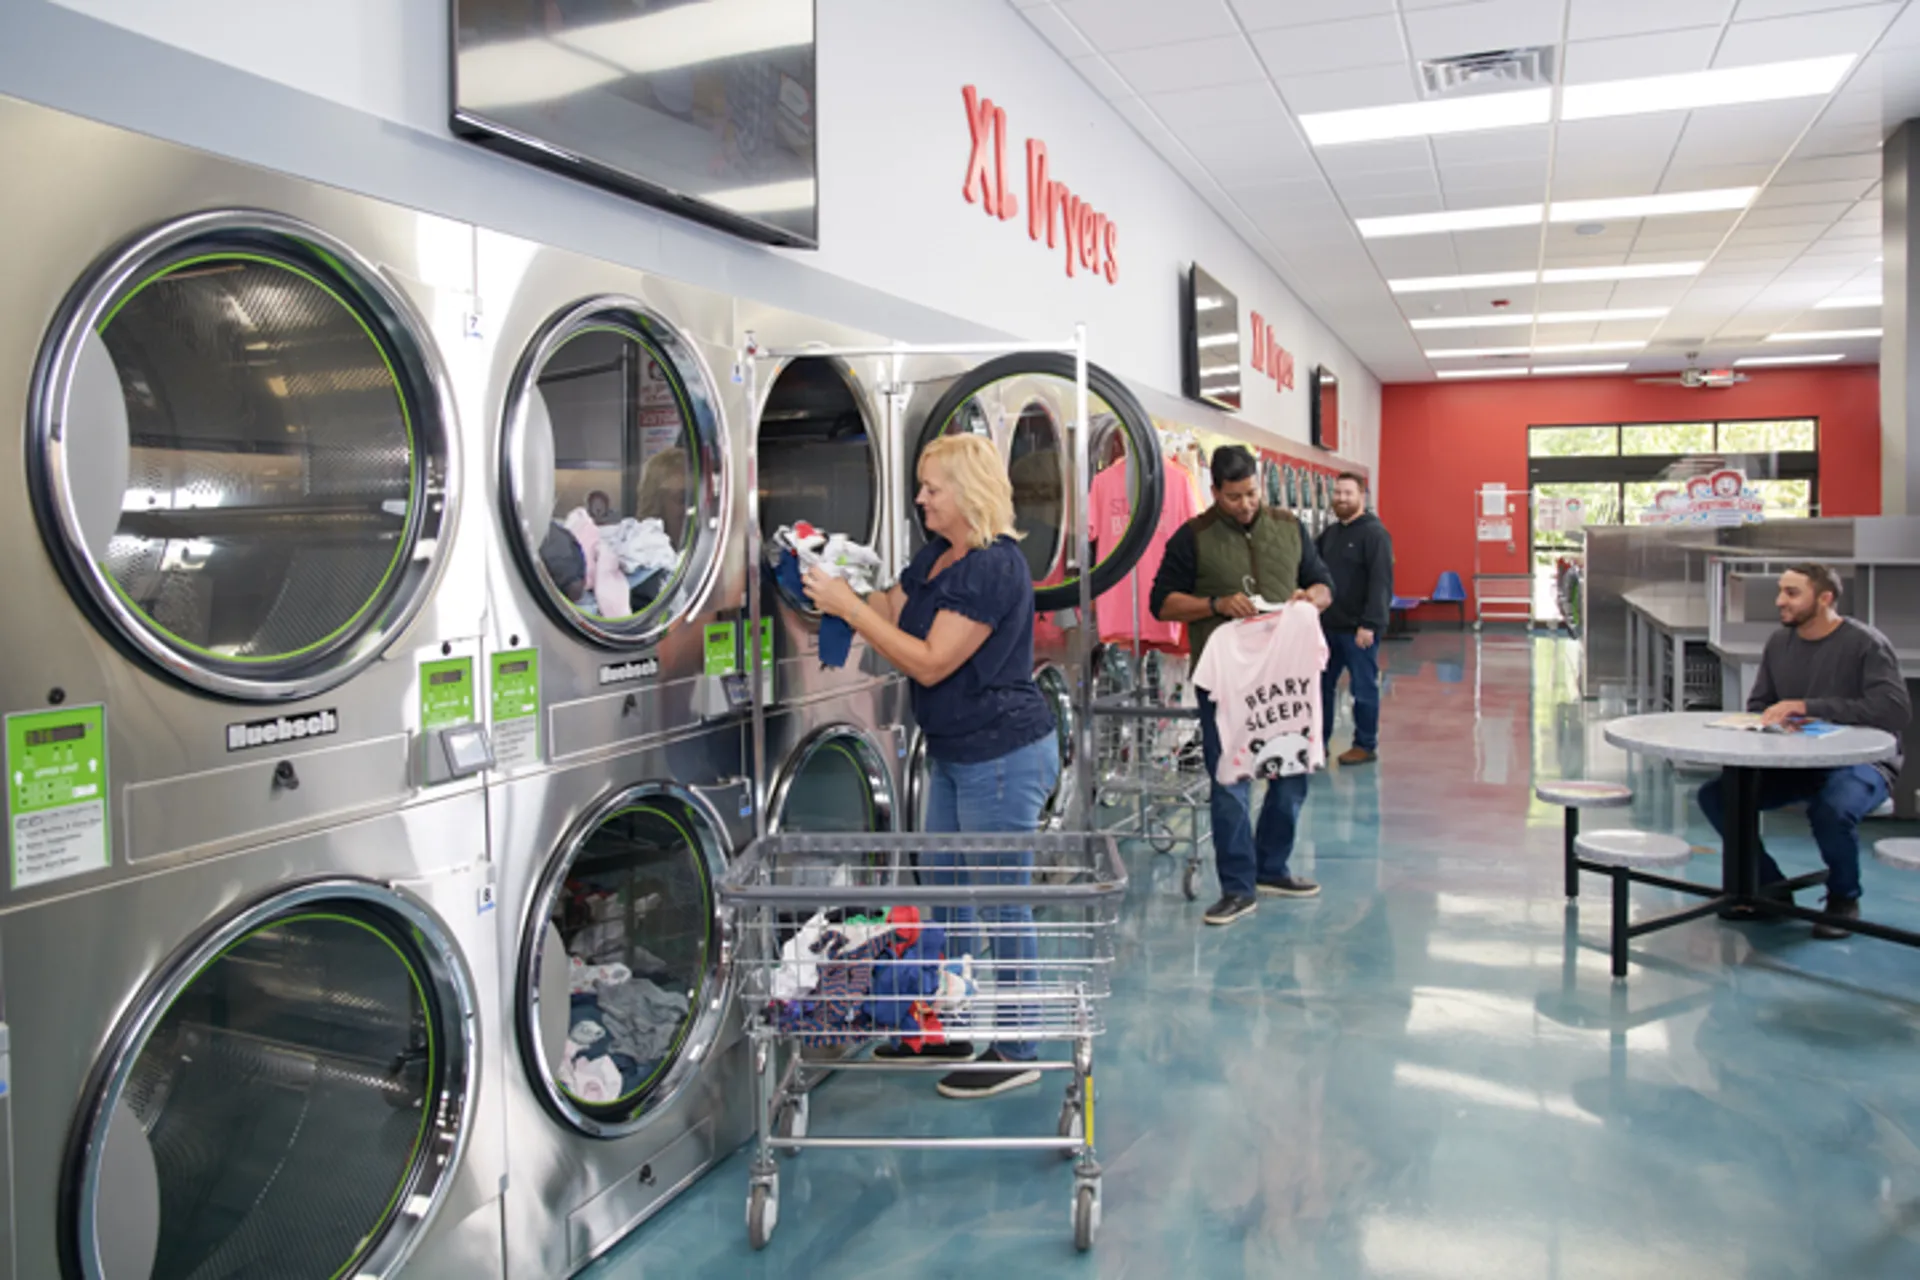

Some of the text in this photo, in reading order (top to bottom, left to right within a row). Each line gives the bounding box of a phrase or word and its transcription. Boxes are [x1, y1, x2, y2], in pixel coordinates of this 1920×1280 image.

[961, 84, 1119, 285] XL Dryers
[1245, 678, 1311, 711] BEARY
[228, 711, 336, 749] Huebsch
